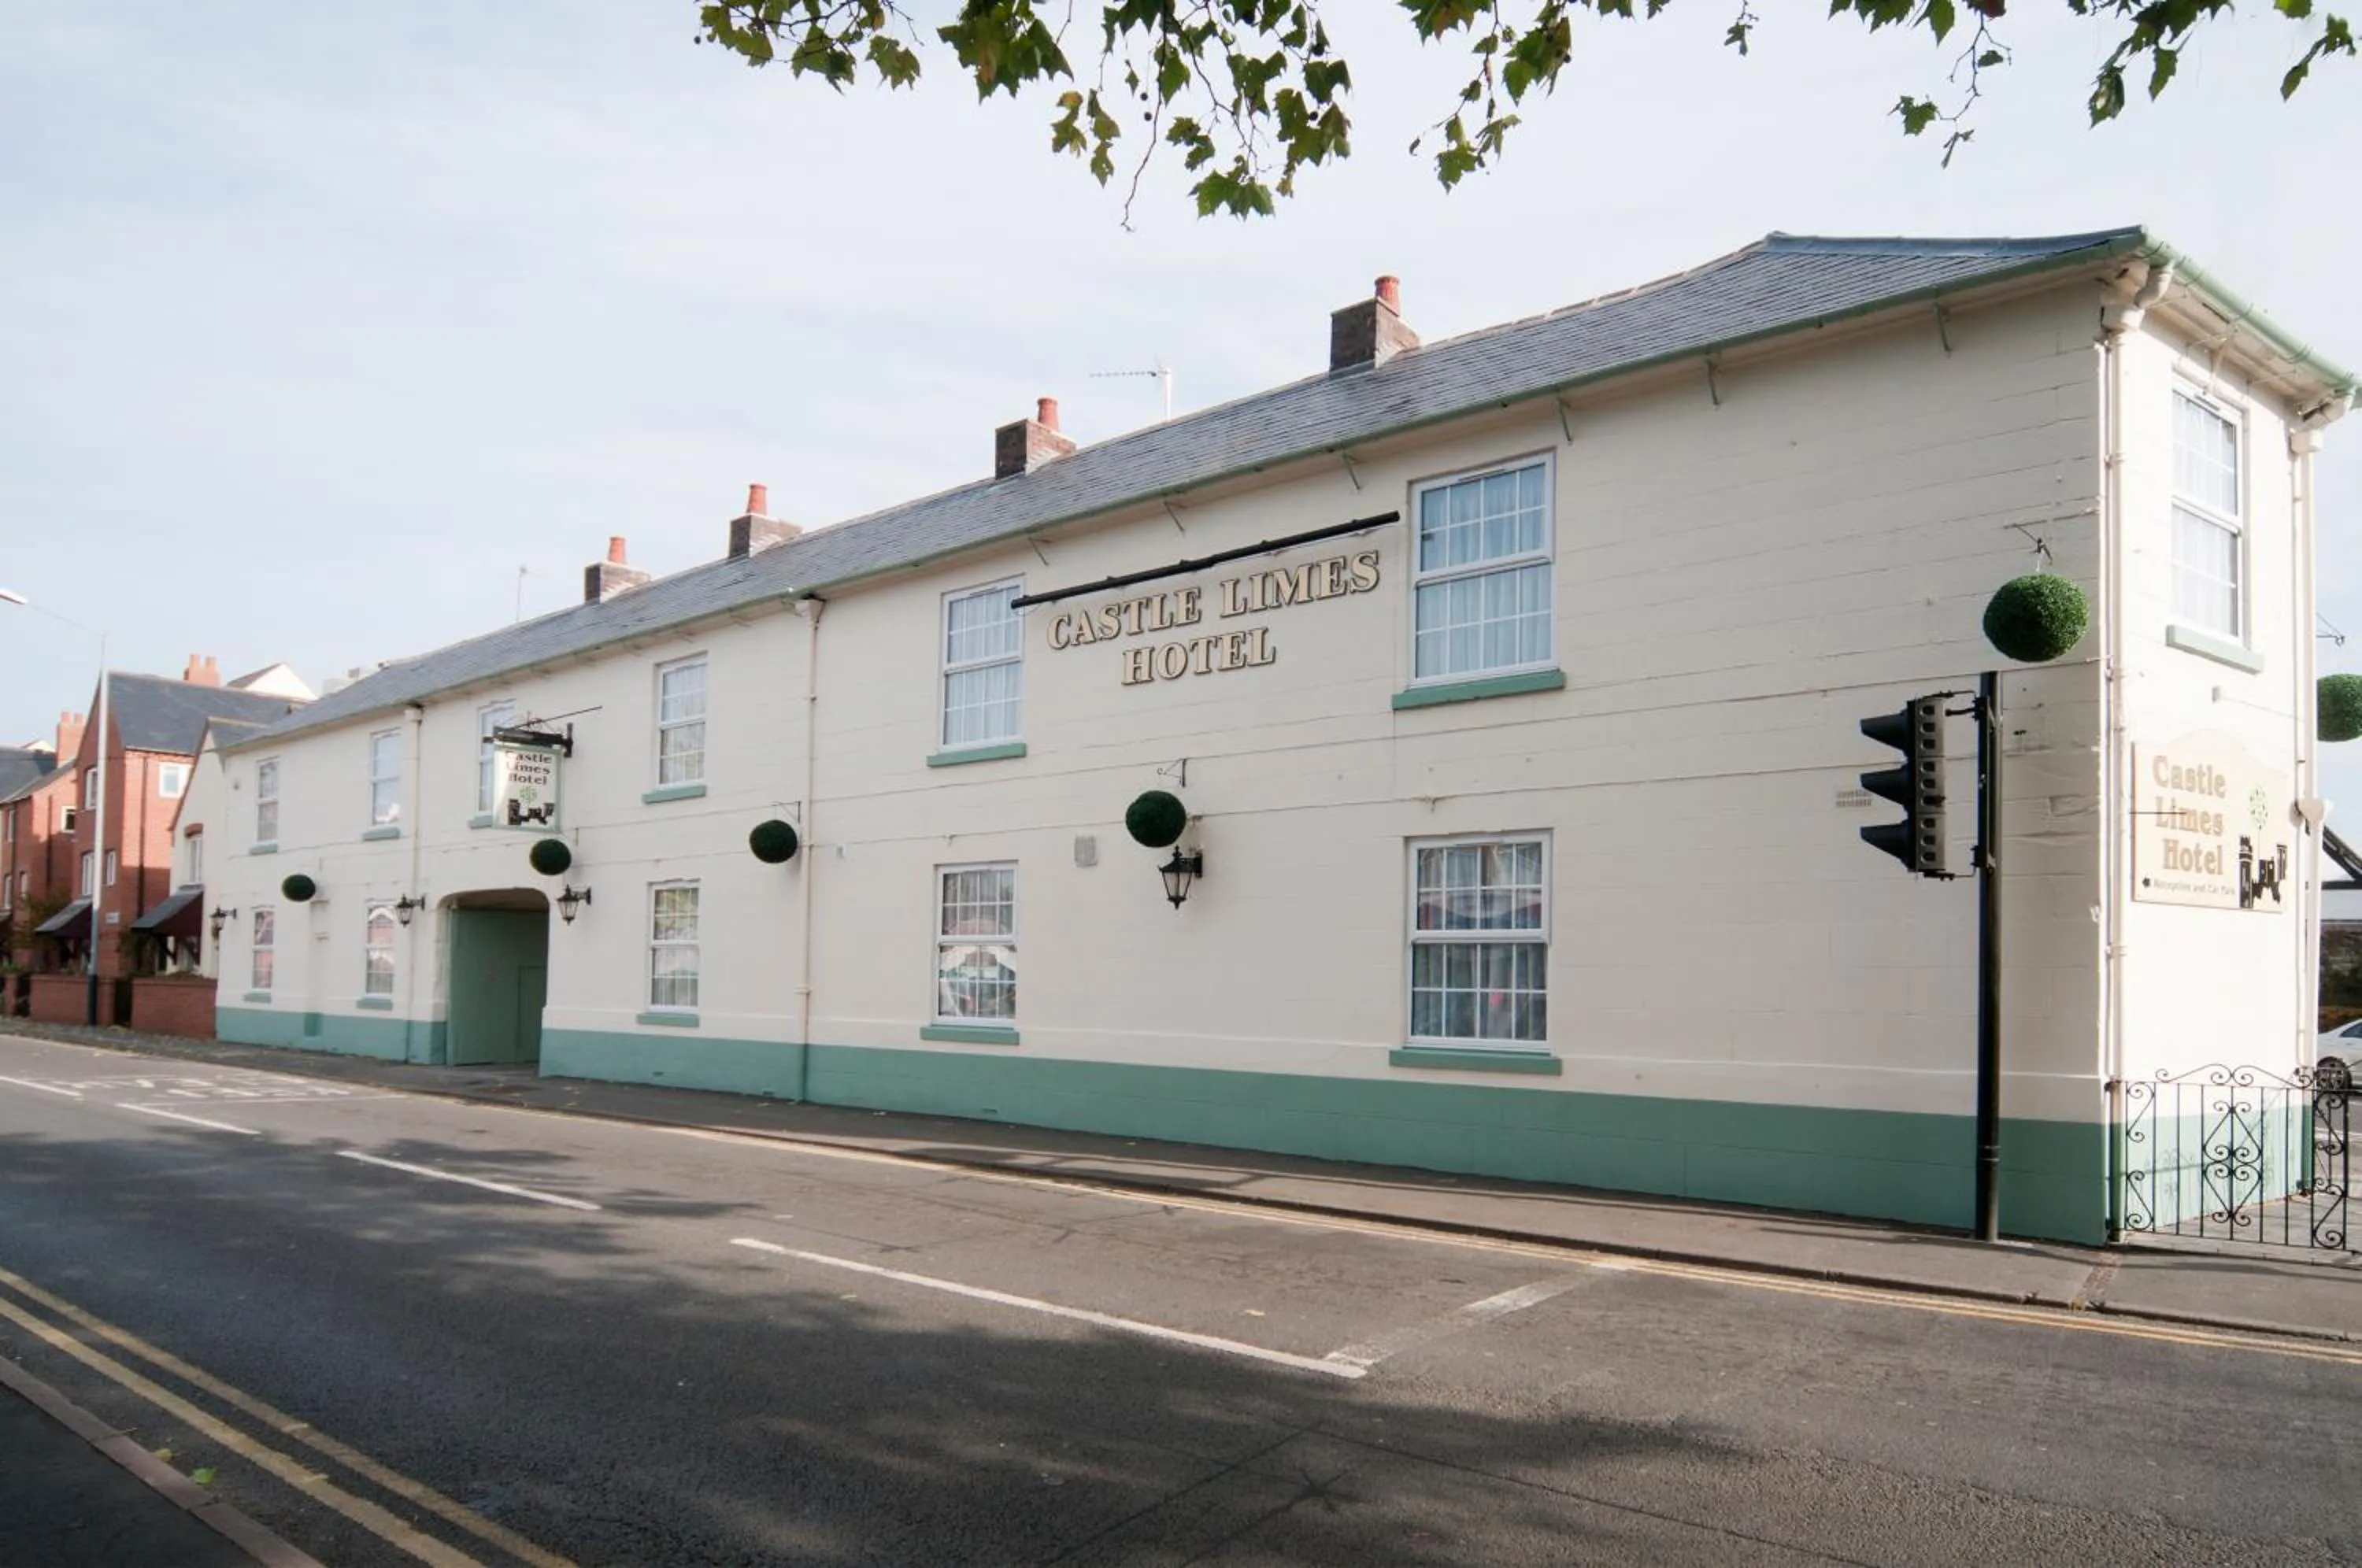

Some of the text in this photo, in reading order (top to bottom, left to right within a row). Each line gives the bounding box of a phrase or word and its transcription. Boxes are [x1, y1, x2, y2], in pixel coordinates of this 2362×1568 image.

[1046, 550, 1381, 650] CASTLE LIMES
[1121, 627, 1276, 686] HOTEL
[2153, 755, 2227, 799] Castle
[2155, 796, 2224, 837] Limes
[2163, 838, 2224, 875] Hotel
